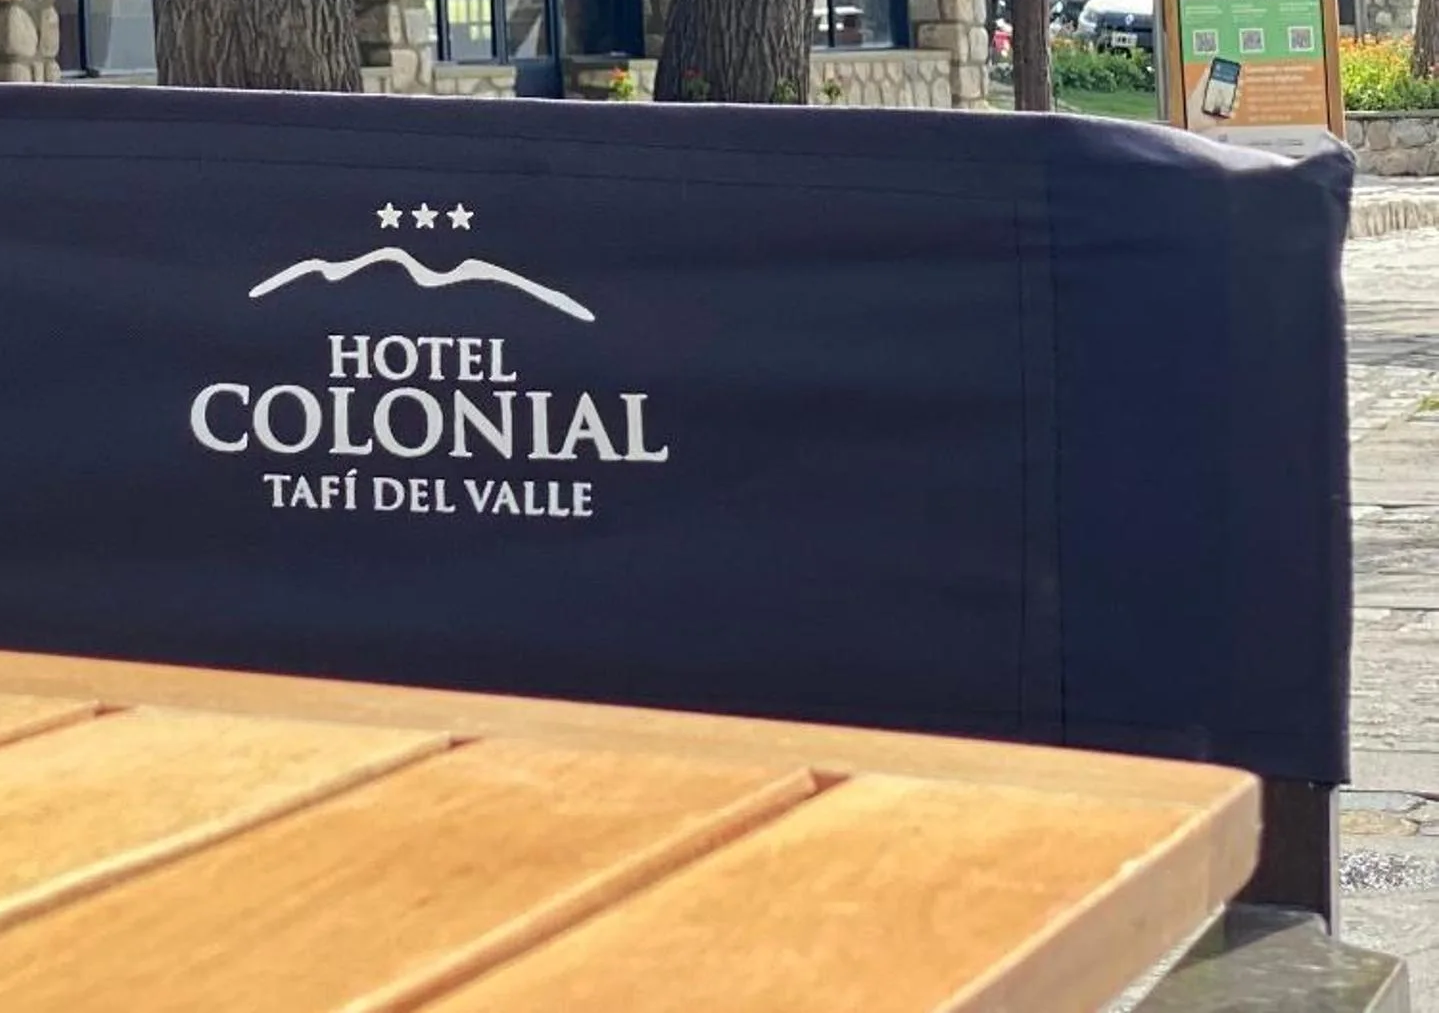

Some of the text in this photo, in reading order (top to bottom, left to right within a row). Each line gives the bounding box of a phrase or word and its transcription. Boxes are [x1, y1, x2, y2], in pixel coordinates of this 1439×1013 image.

[328, 334, 517, 383] HOTEL
[190, 382, 669, 462] COLONIAL
[263, 468, 593, 517] TAFÍ DEL VALLE
